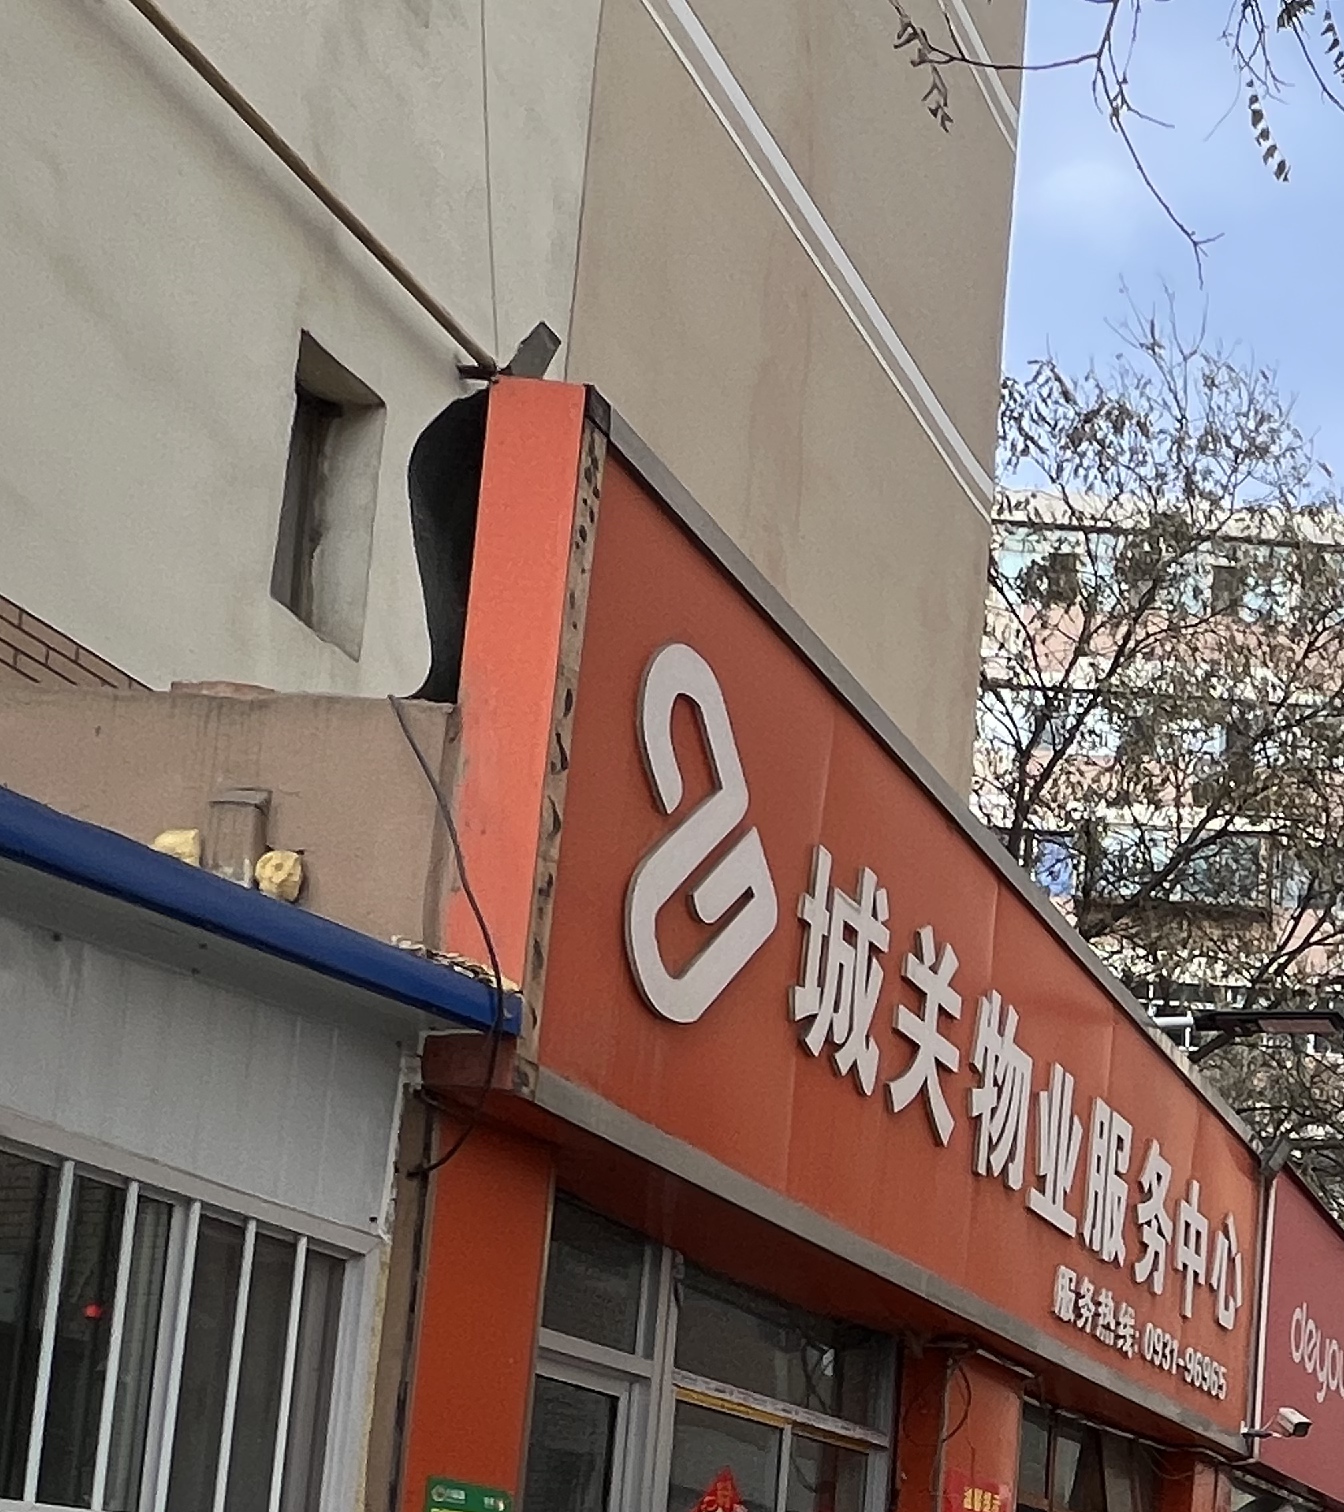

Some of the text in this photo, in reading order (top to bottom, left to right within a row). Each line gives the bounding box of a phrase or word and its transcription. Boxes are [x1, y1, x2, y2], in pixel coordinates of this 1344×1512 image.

[790, 844, 1243, 1331] 城关物业服务中心
[1144, 1322, 1228, 1401] 0931-96965
